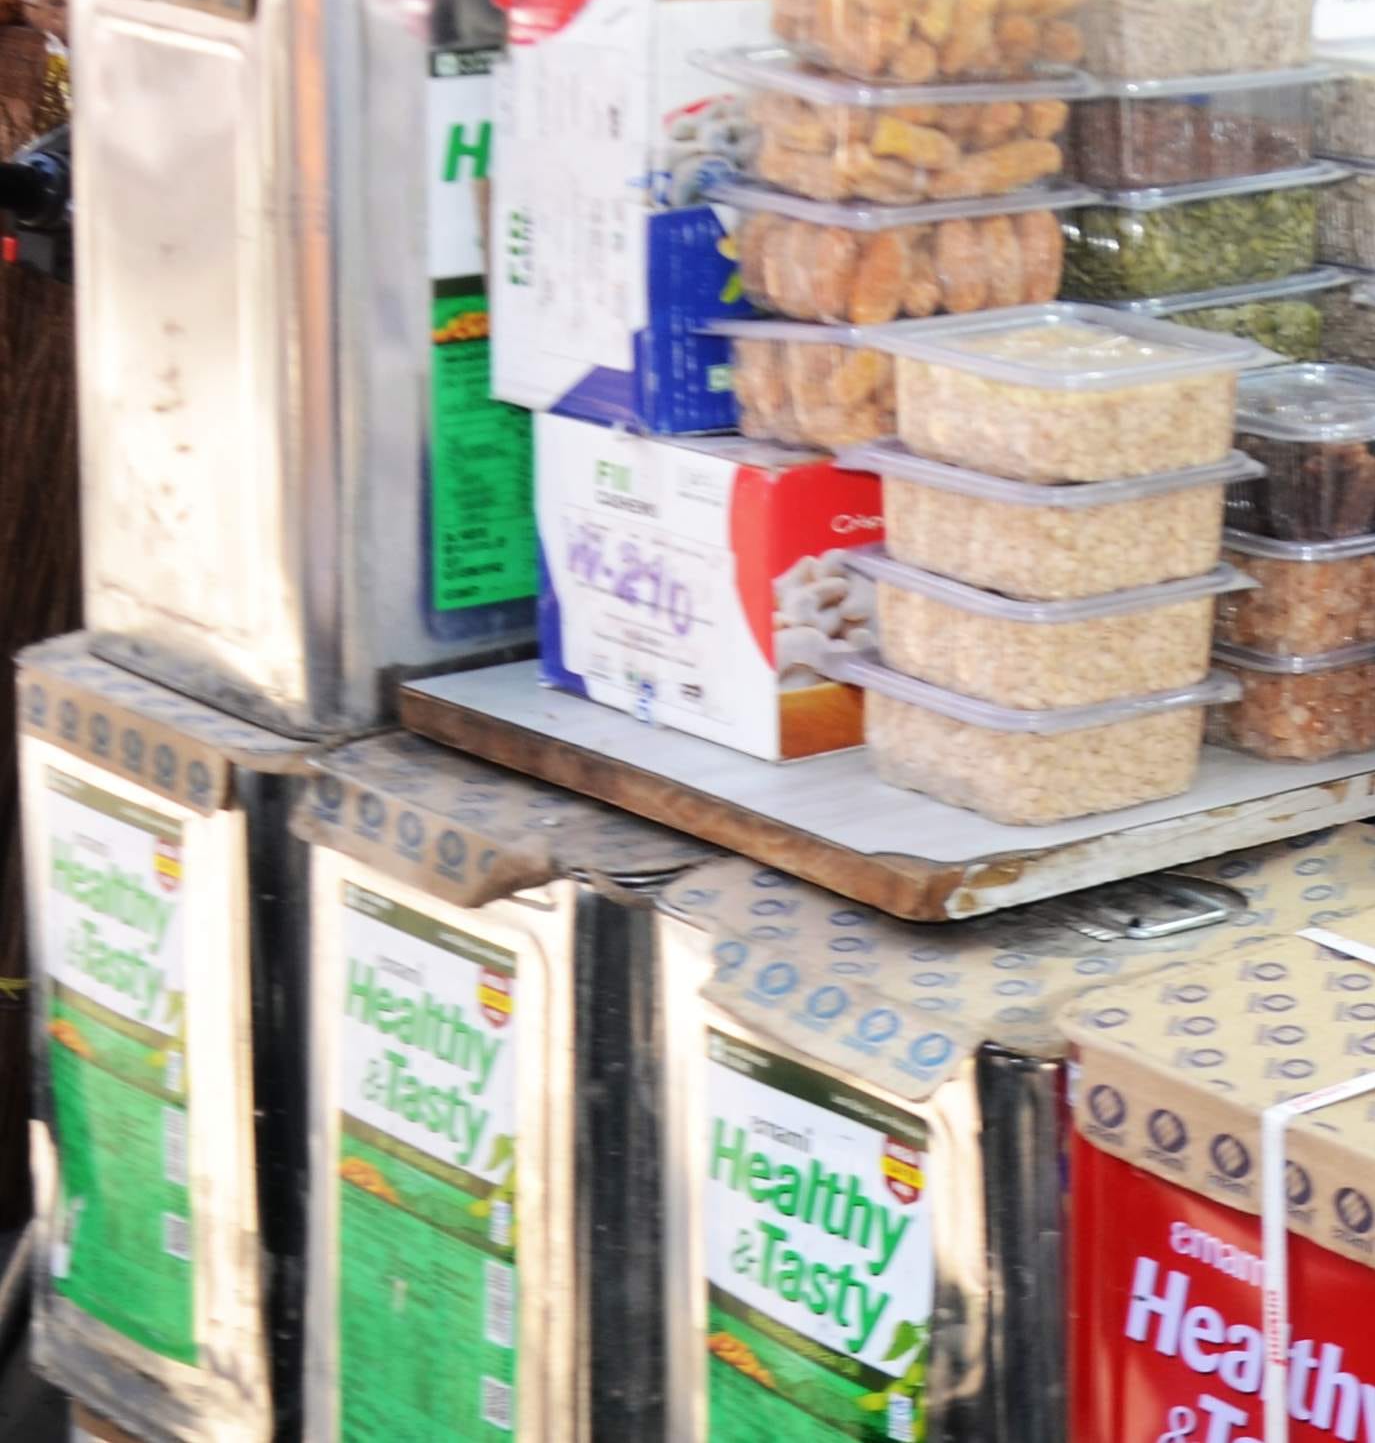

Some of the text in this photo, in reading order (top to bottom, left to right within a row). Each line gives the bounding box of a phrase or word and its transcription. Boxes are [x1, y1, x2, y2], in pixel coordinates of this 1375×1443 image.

[50, 834, 176, 955] Healthy
[344, 956, 502, 1097] Healthy
[708, 1114, 914, 1277] Healthy
[1169, 1220, 1266, 1287] emam
